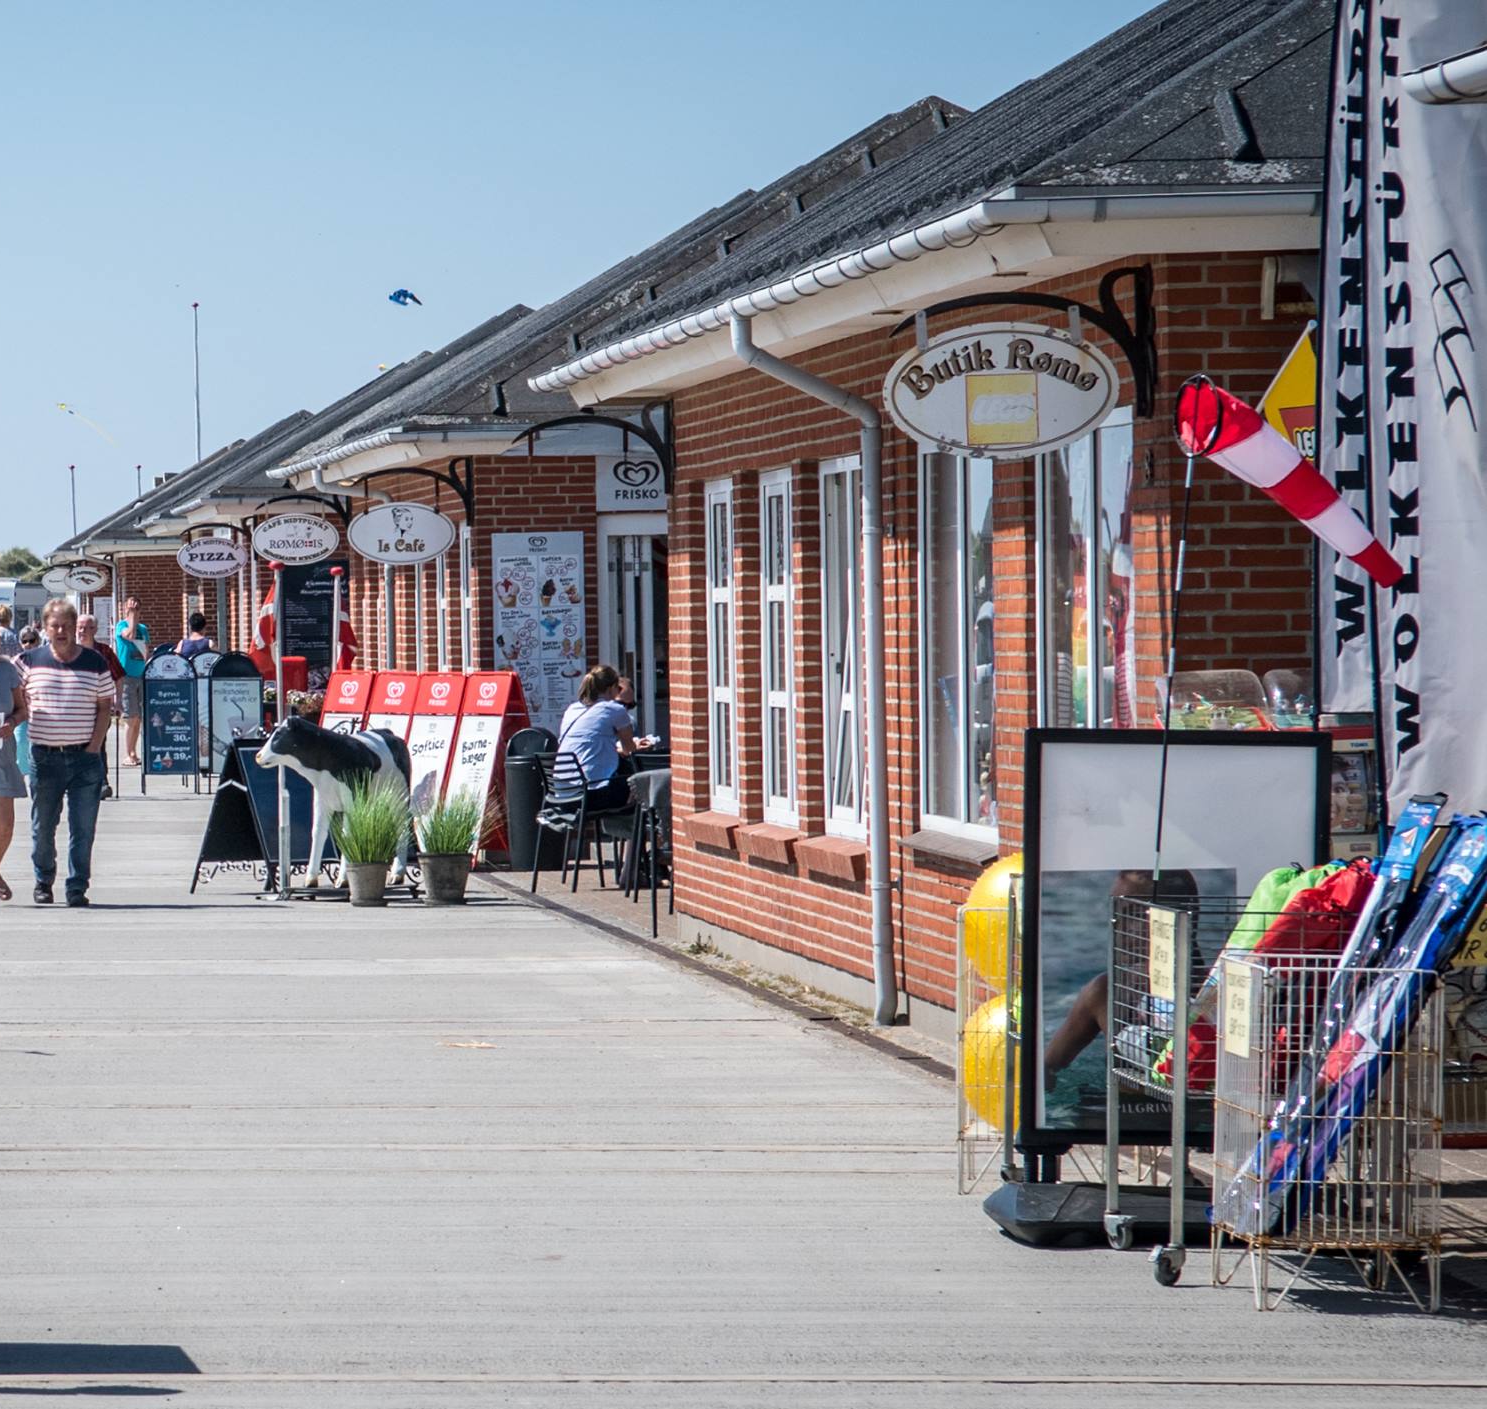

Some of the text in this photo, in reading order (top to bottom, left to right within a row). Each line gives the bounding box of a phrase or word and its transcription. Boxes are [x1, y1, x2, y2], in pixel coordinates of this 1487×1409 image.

[901, 338, 1100, 400] Butik Rømø
[1294, 427, 1316, 459] LE
[615, 489, 659, 500] FRISKO
[269, 539, 323, 549] RØMØ IS
[378, 538, 425, 553] Is Café
[188, 552, 237, 562] PIZZA
[412, 738, 445, 756] Softice
